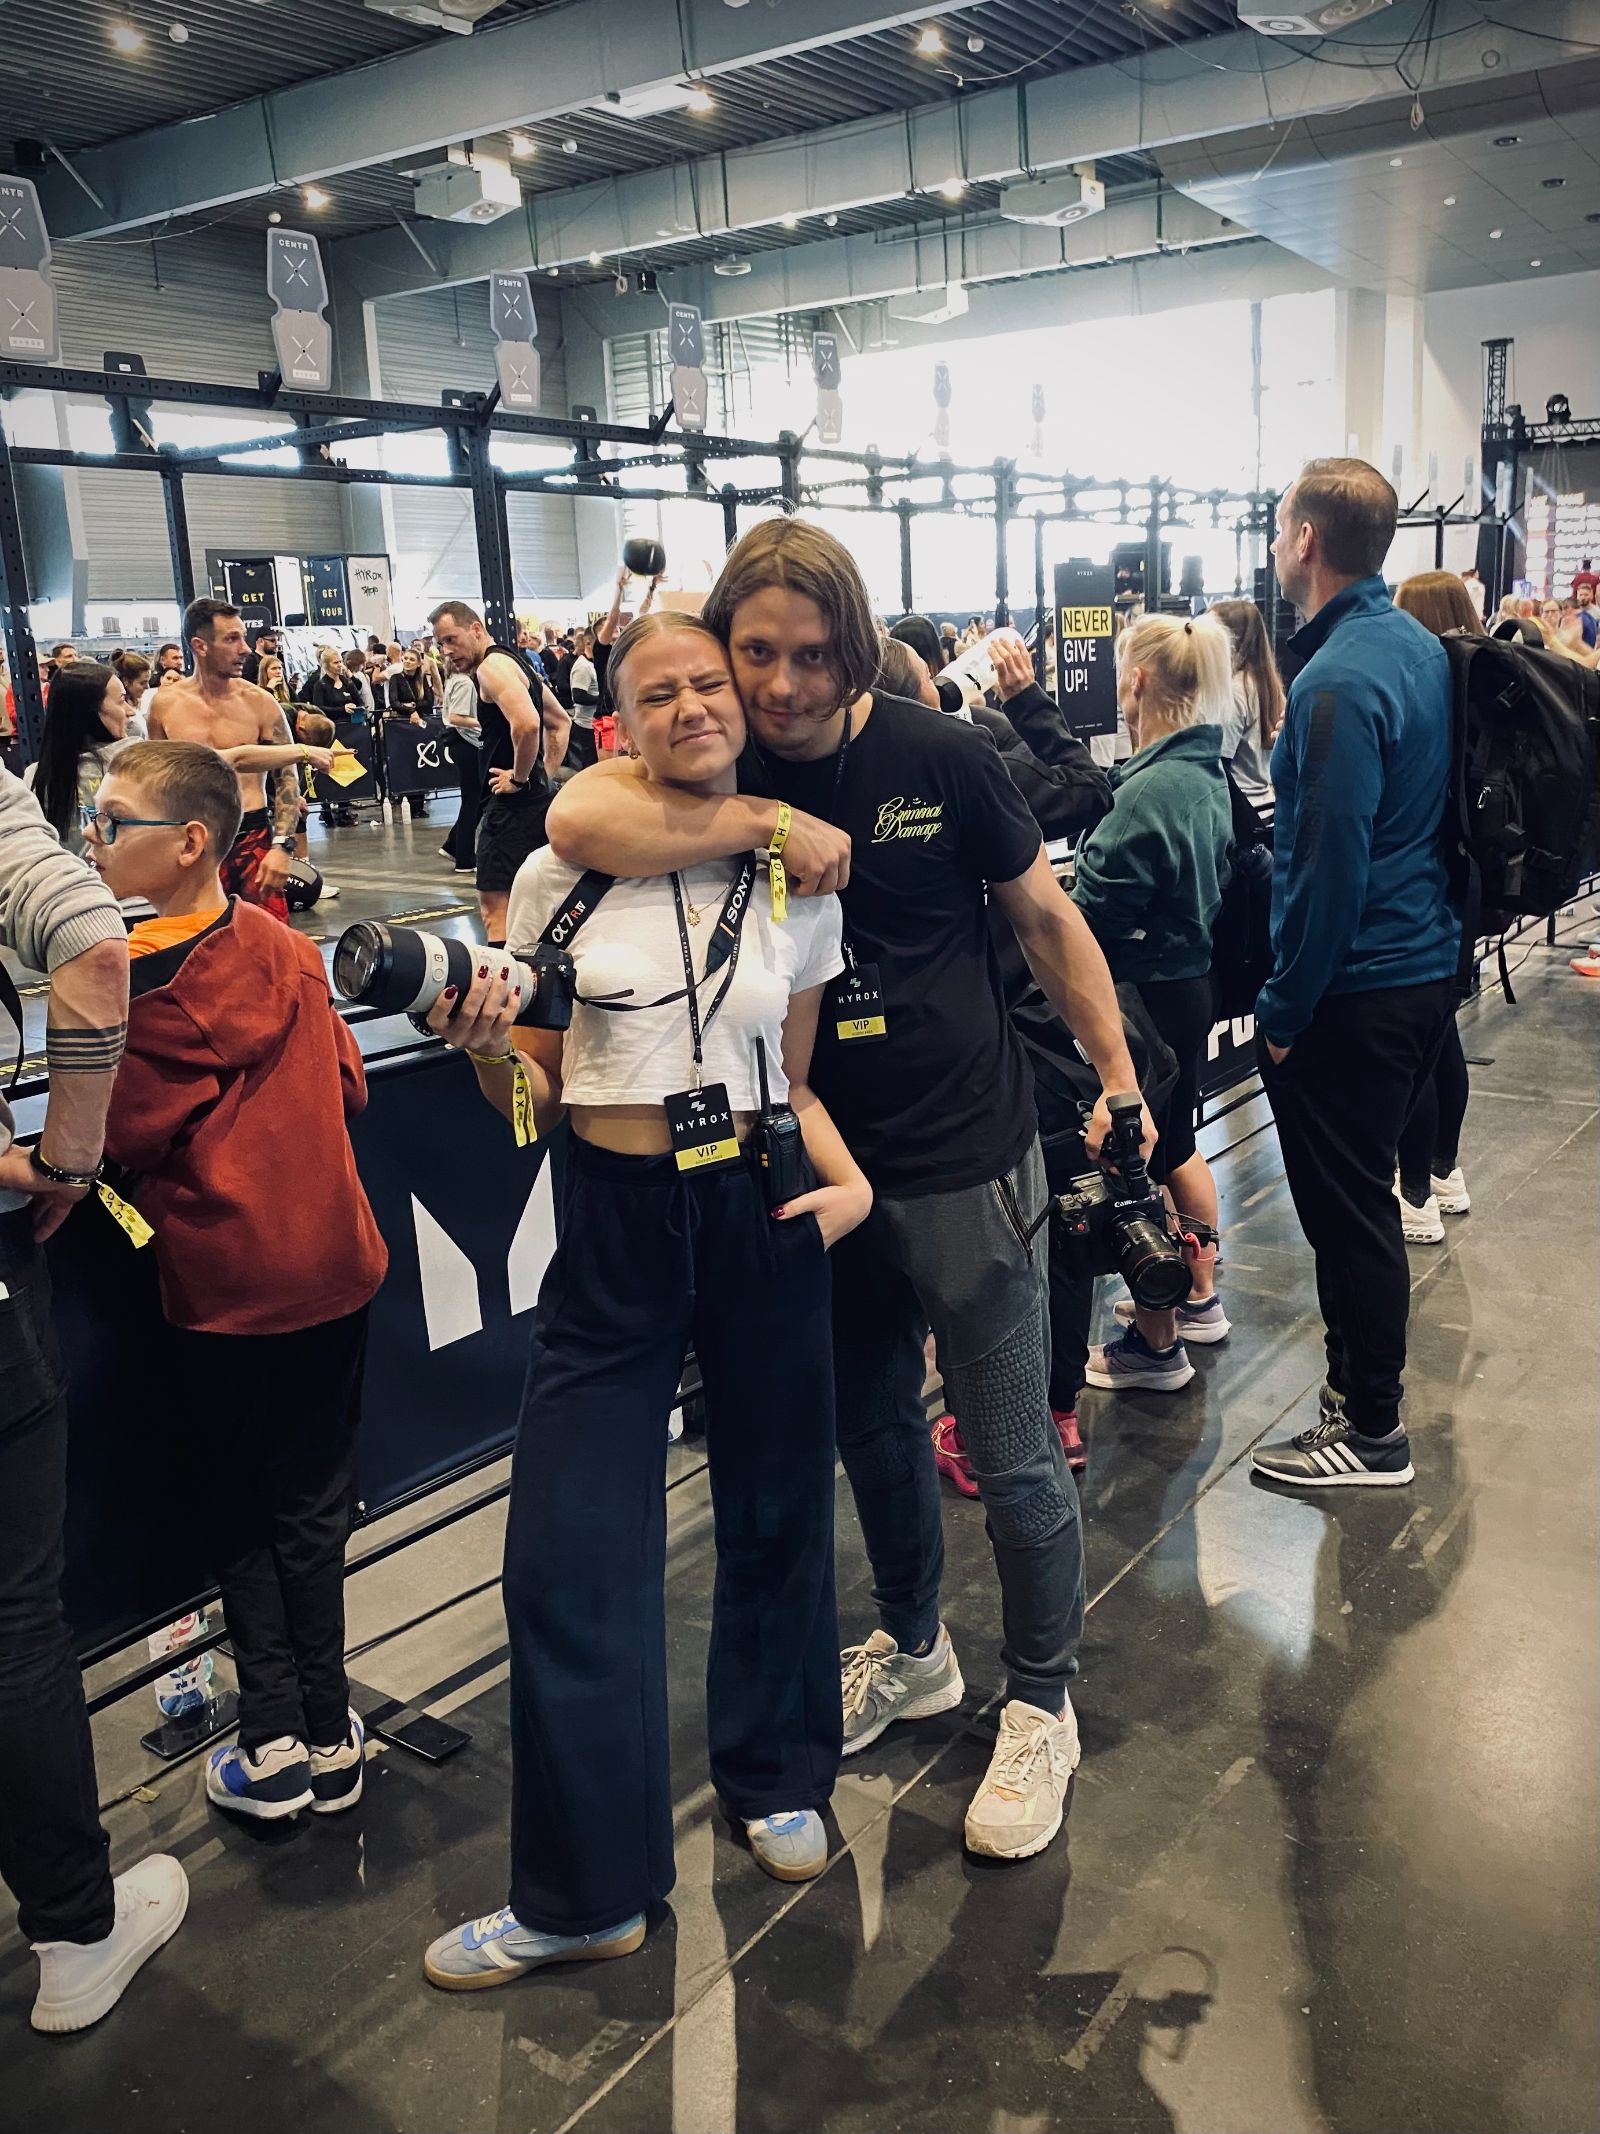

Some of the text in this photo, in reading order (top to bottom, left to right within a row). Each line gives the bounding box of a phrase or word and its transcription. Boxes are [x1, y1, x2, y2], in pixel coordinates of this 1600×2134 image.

[0, 187, 24, 198] NTR
[278, 239, 309, 250] CENTR
[242, 593, 265, 603] GET
[322, 588, 338, 599] GET
[320, 608, 343, 617] YOUR
[1063, 609, 1109, 633] NEVER
[1063, 638, 1097, 663] GIVE
[1064, 668, 1088, 693] UP!
[875, 796, 944, 835] Criminal
[871, 817, 943, 843] Damage
[726, 863, 751, 925] SONY
[838, 990, 878, 1004] HYROX
[853, 1019, 870, 1031] VIP
[675, 1111, 729, 1132] HYROX
[696, 1144, 718, 1158] VIP
